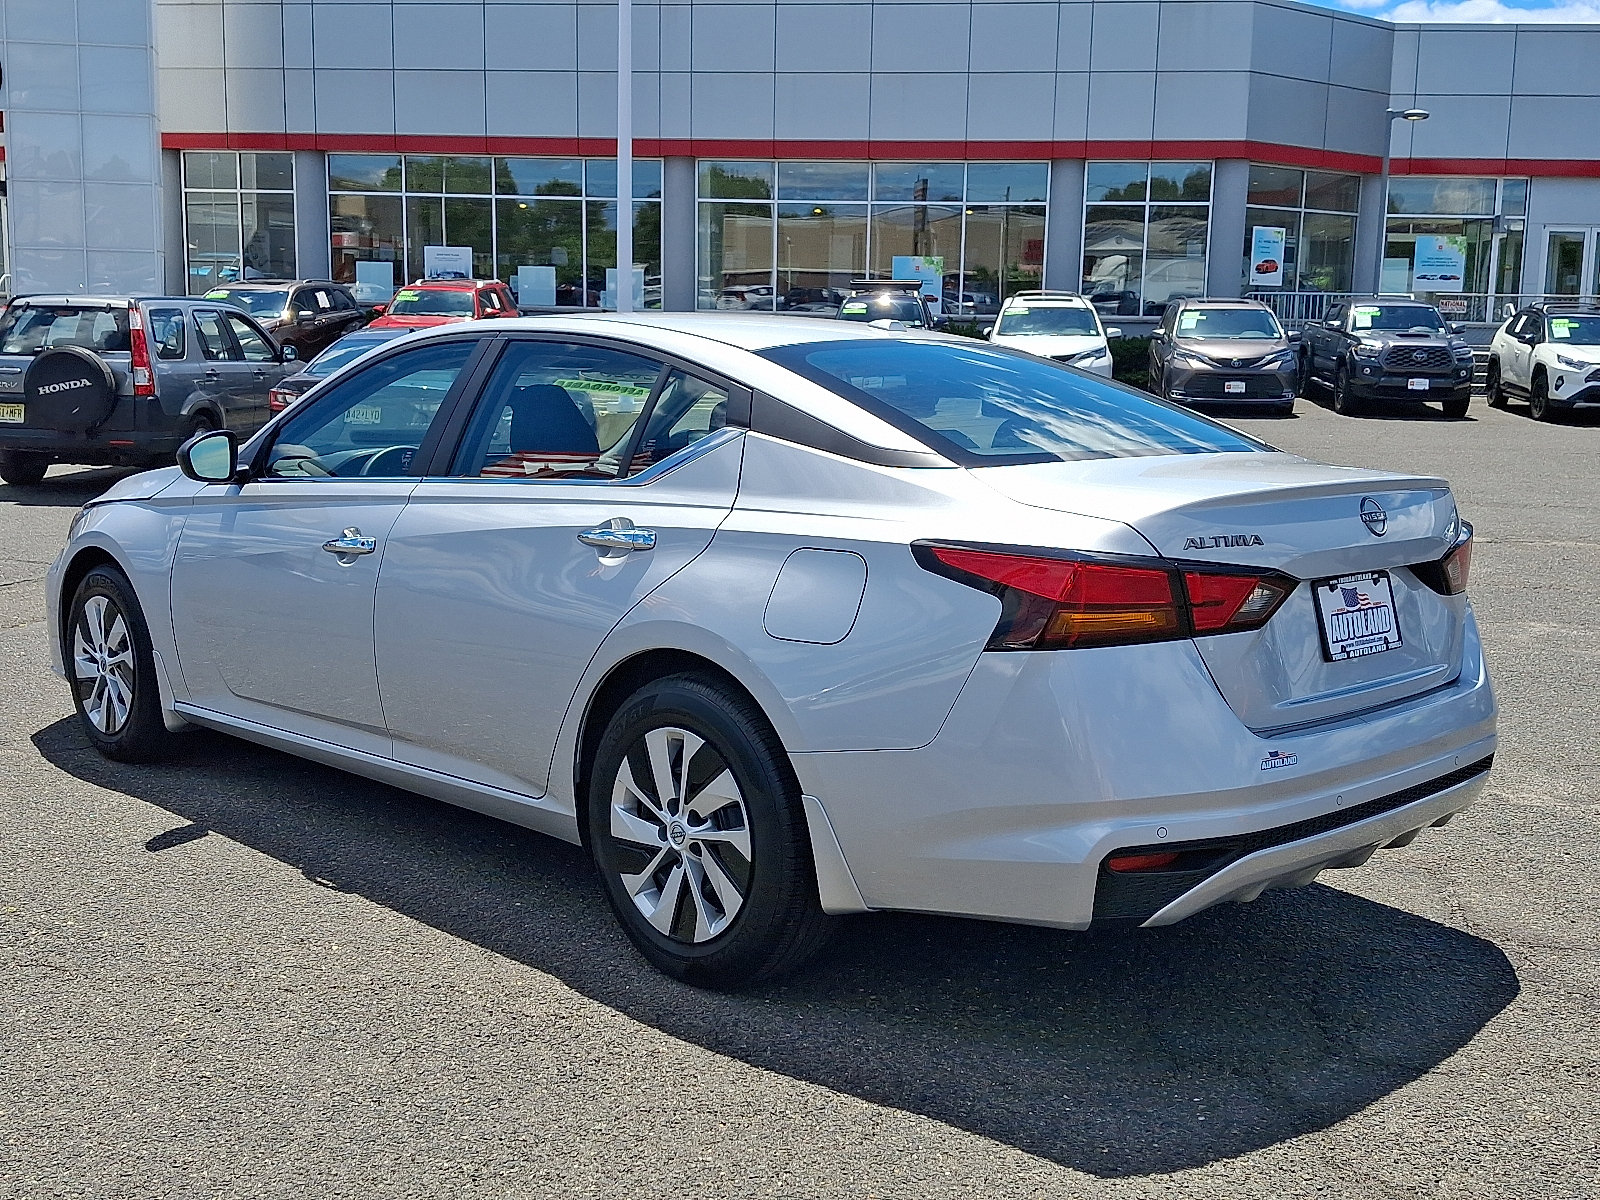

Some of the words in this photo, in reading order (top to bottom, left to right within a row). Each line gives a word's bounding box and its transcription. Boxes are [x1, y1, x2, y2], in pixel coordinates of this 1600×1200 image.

[37, 378, 93, 395] HONDA
[1183, 534, 1265, 550] ALTIMA
[1331, 606, 1391, 644] AUTOLAND
[1349, 643, 1387, 658] AUTOLAND
[1261, 755, 1298, 770] AUTOLAND
